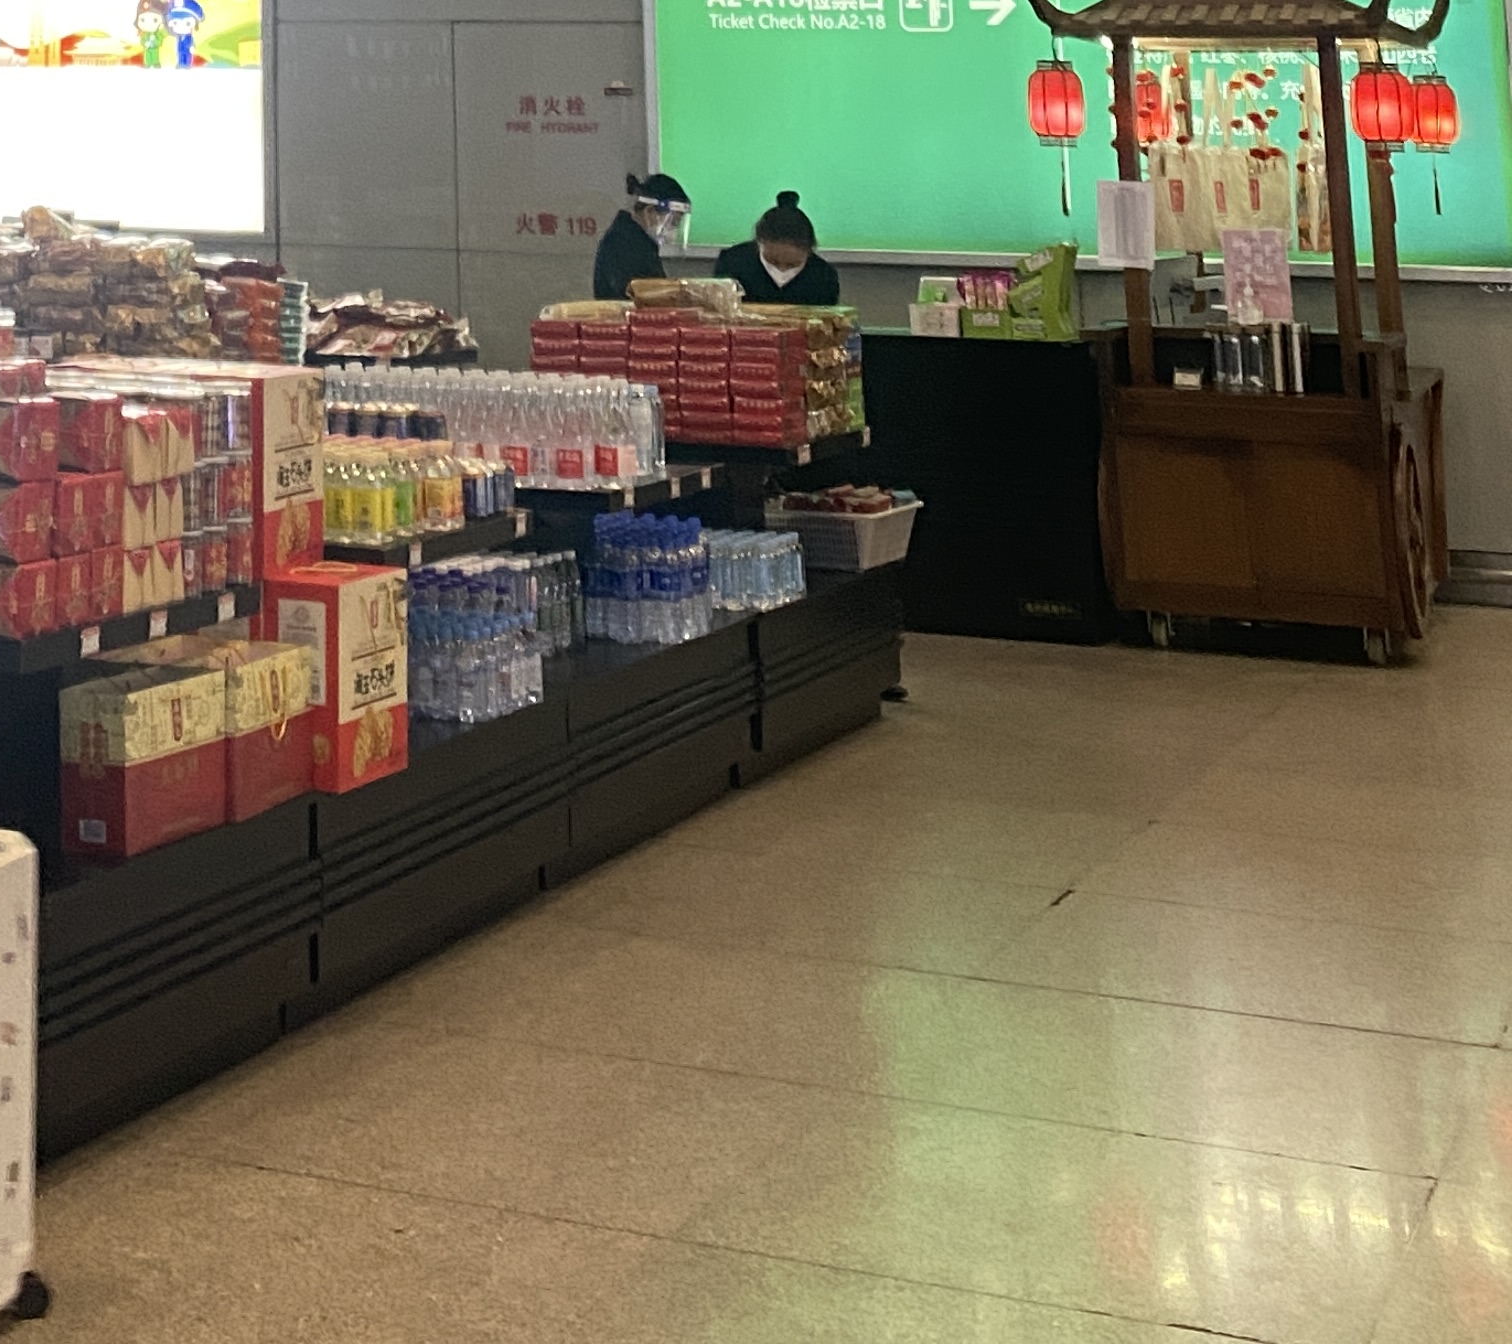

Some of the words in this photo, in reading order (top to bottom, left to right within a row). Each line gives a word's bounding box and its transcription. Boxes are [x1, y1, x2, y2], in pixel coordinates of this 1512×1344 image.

[710, 14, 754, 30] Ticket
[758, 13, 806, 29] Check
[810, 14, 886, 30] No.A2-18
[506, 122, 532, 133] FIRE
[540, 122, 600, 133] HYDRANT
